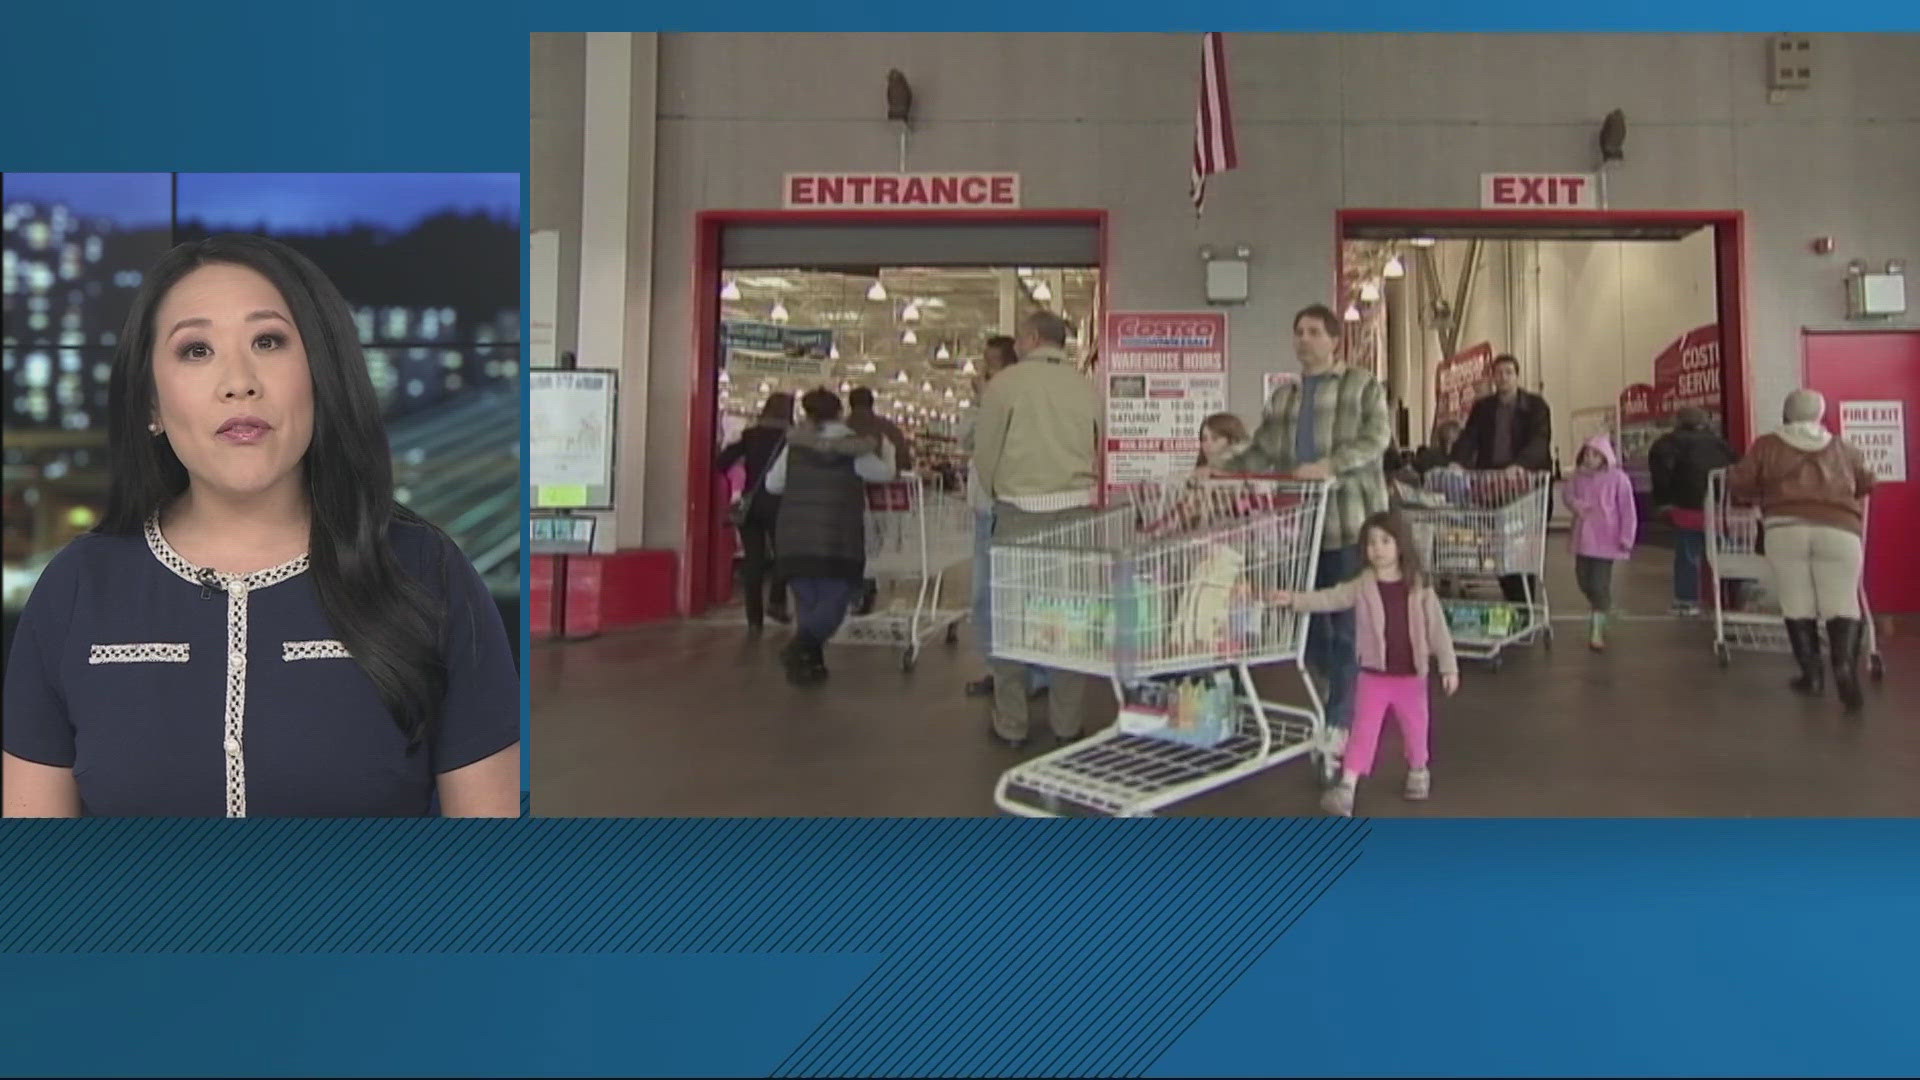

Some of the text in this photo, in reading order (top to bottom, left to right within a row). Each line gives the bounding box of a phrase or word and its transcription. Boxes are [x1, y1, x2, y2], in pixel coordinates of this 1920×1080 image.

[790, 176, 1015, 205] ENTRANCE
[1493, 177, 1585, 204] EXIT
[1118, 318, 1217, 338] COSTCO
[1110, 352, 1222, 370] WAREHOUSE HOURS
[1110, 401, 1134, 410] MON
[1144, 401, 1160, 410] FRI
[1110, 412, 1161, 423] SATURDAY
[1842, 408, 1899, 421] FIRE EXIT
[1110, 426, 1149, 436] SUNDAY
[1850, 433, 1893, 446] PLEASE
